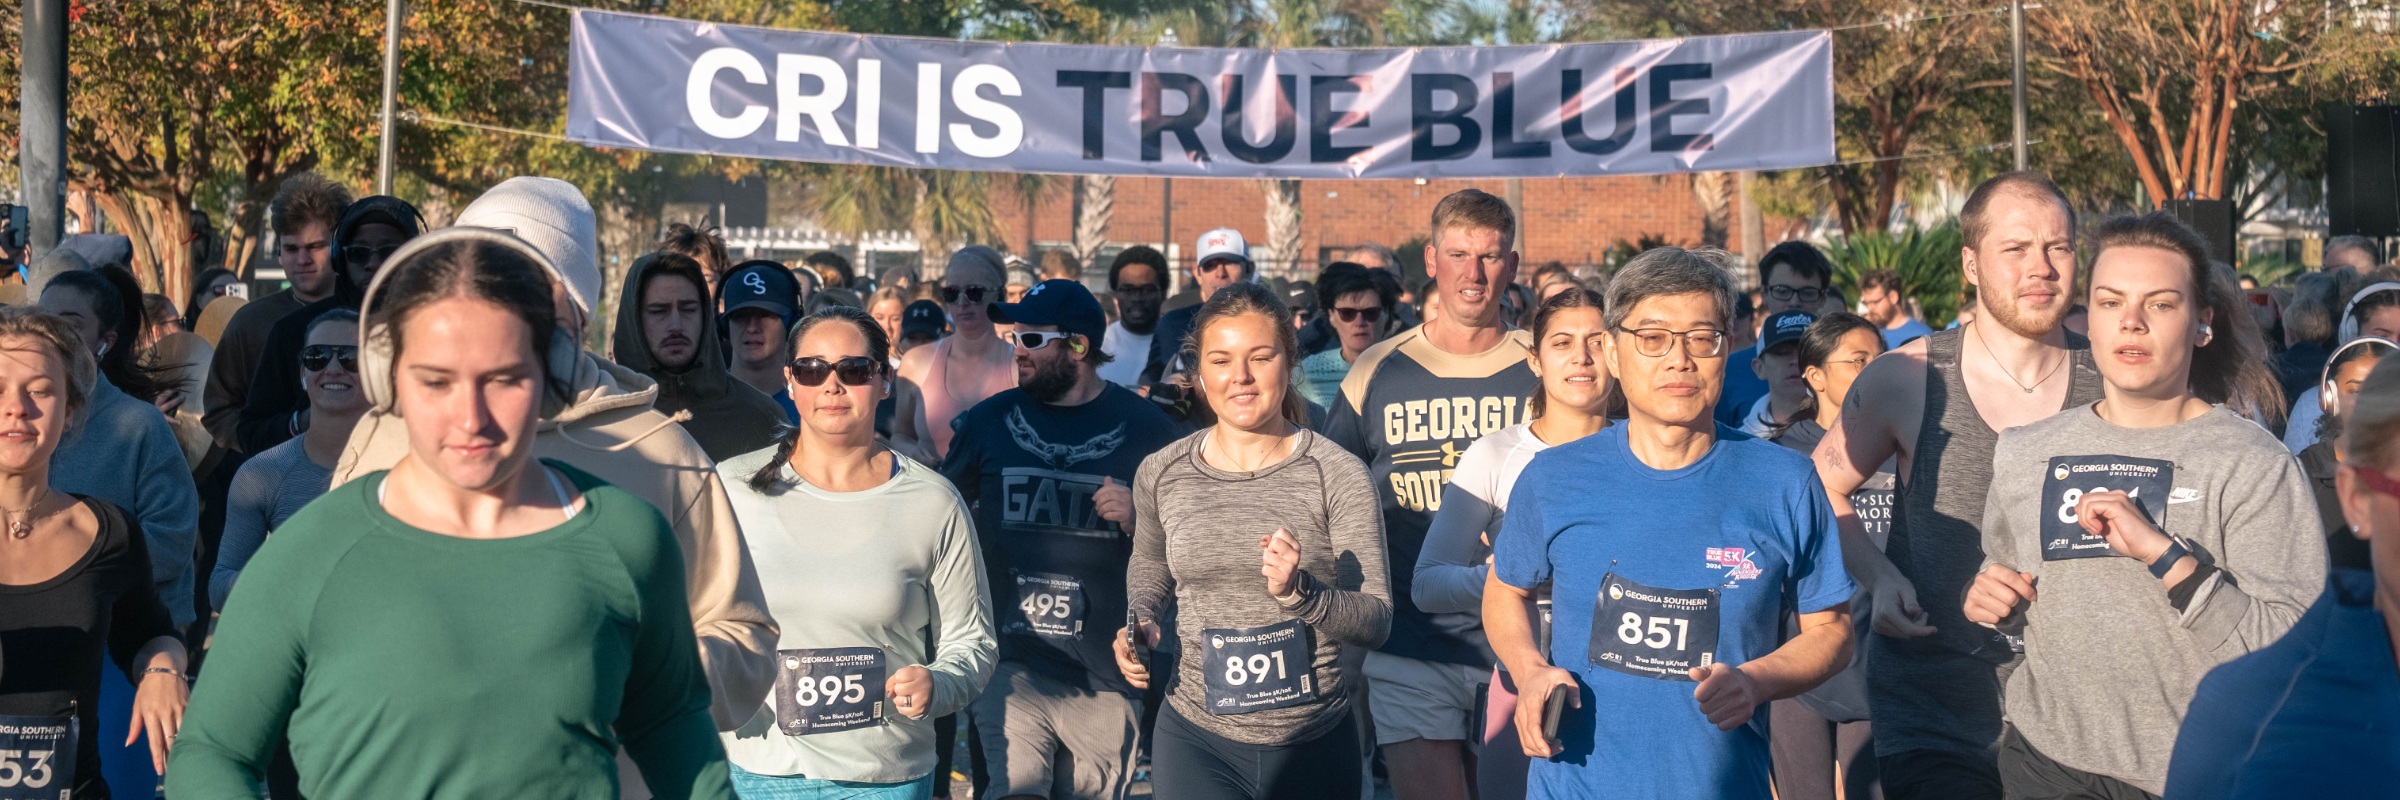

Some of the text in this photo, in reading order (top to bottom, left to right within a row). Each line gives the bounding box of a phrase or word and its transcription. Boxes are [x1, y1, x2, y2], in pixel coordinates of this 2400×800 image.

[686, 47, 1715, 164] CRI IS TRUE BLUE
[1775, 313, 1813, 328] Eagles
[2072, 463, 2159, 474] GEORGIA SOUTHERN
[2171, 487, 2198, 497] NIKE
[2071, 542, 2111, 550] Homecoming
[1724, 551, 1741, 562] 5K
[1625, 590, 1708, 606] GEORGIA SOUTHERN
[1019, 592, 1071, 619] 495
[1662, 603, 1708, 611] UNIVERSITY
[1225, 627, 1295, 643] GEORGIA SOUTHERN
[1617, 611, 1689, 651] 851
[1257, 634, 1295, 646] UNIVERSITY
[801, 654, 874, 664] GEORGIA SOUTHERN
[1609, 651, 1623, 660] CRI
[1635, 655, 1649, 663] True
[1650, 657, 1665, 665] Blue
[1225, 650, 1287, 686] 891
[1625, 661, 1667, 674] Homecoming
[1667, 666, 1689, 675] Weeke
[795, 674, 866, 707] 895
[1239, 692, 1300, 707] Homecoming Weekend
[811, 716, 871, 728] Homecoming Weekend
[21, 725, 67, 735] SOUTHERN
